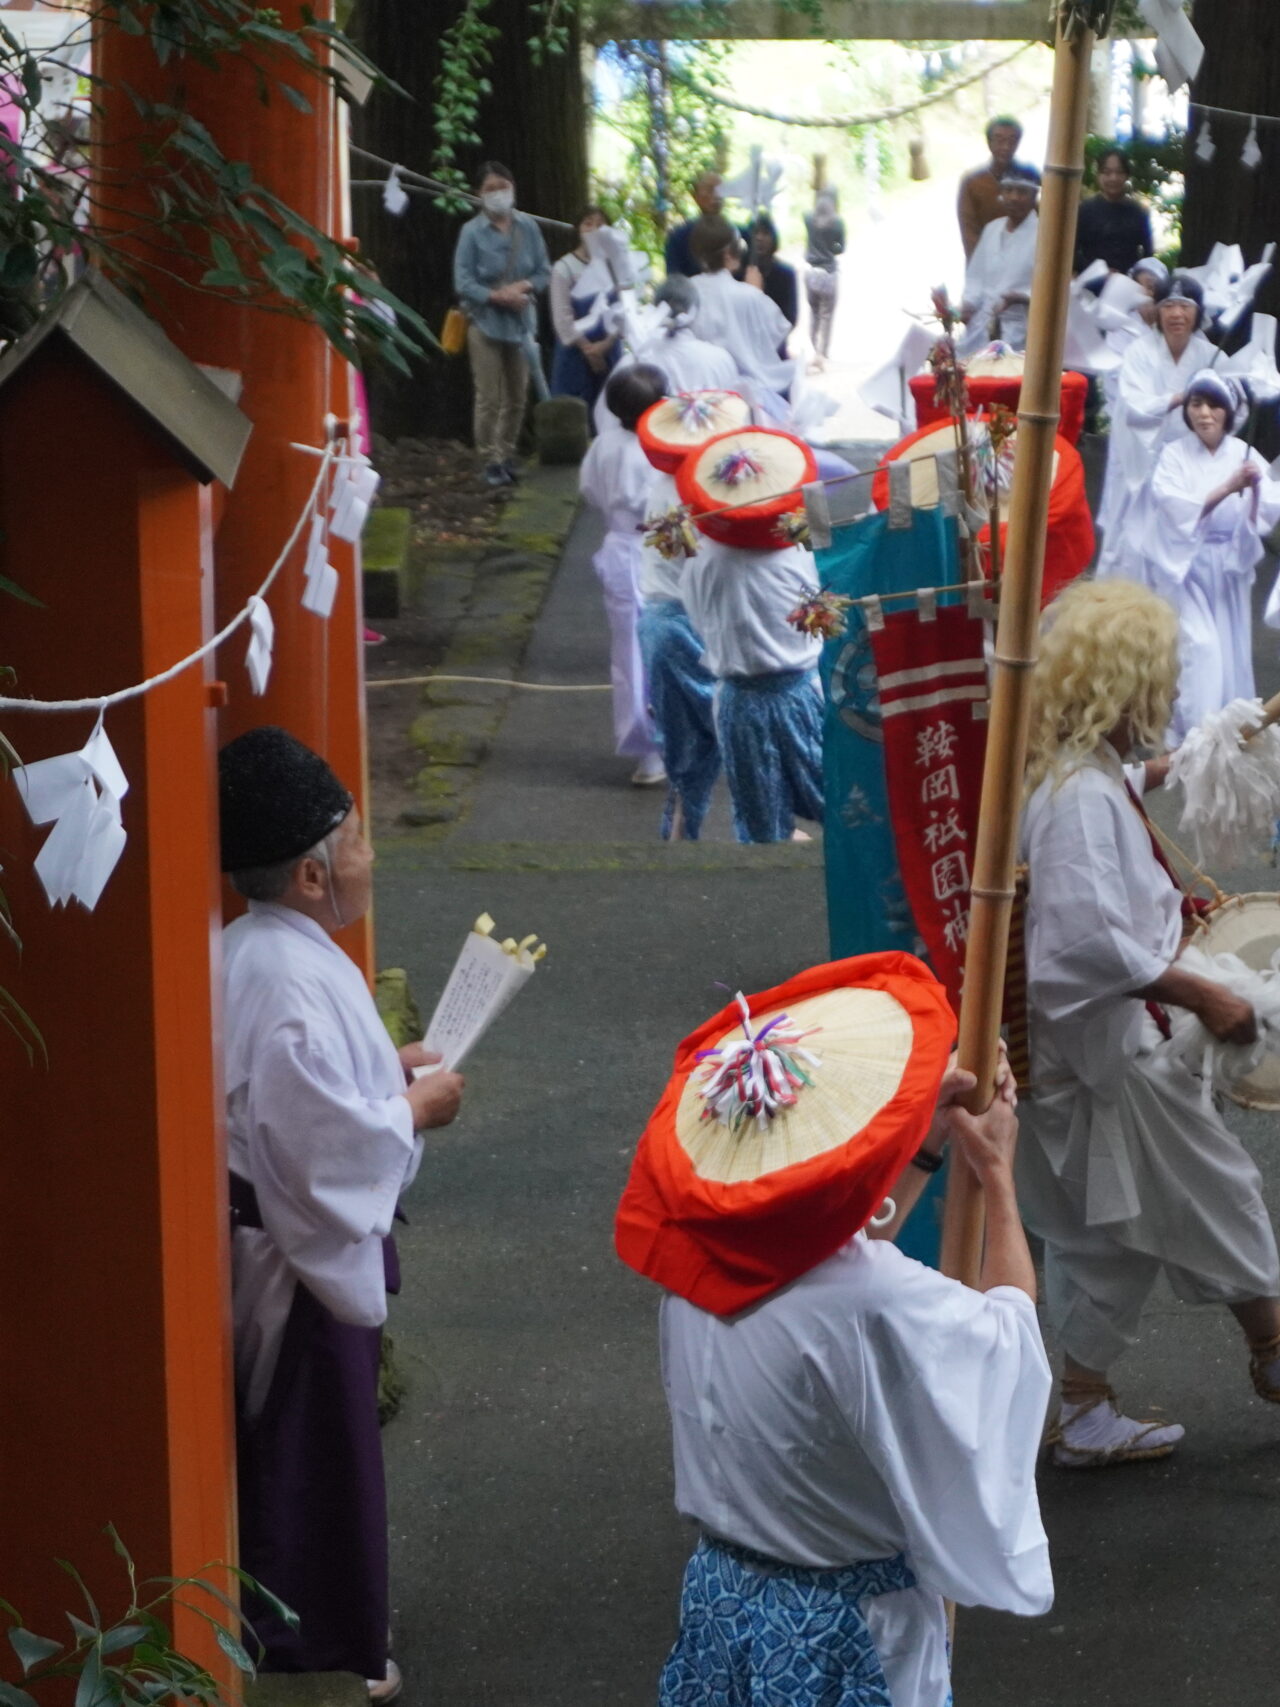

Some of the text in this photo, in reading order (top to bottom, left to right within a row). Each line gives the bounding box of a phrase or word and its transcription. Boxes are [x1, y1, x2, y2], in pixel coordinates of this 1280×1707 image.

[914, 720, 971, 995] 鞍岡祇園神
